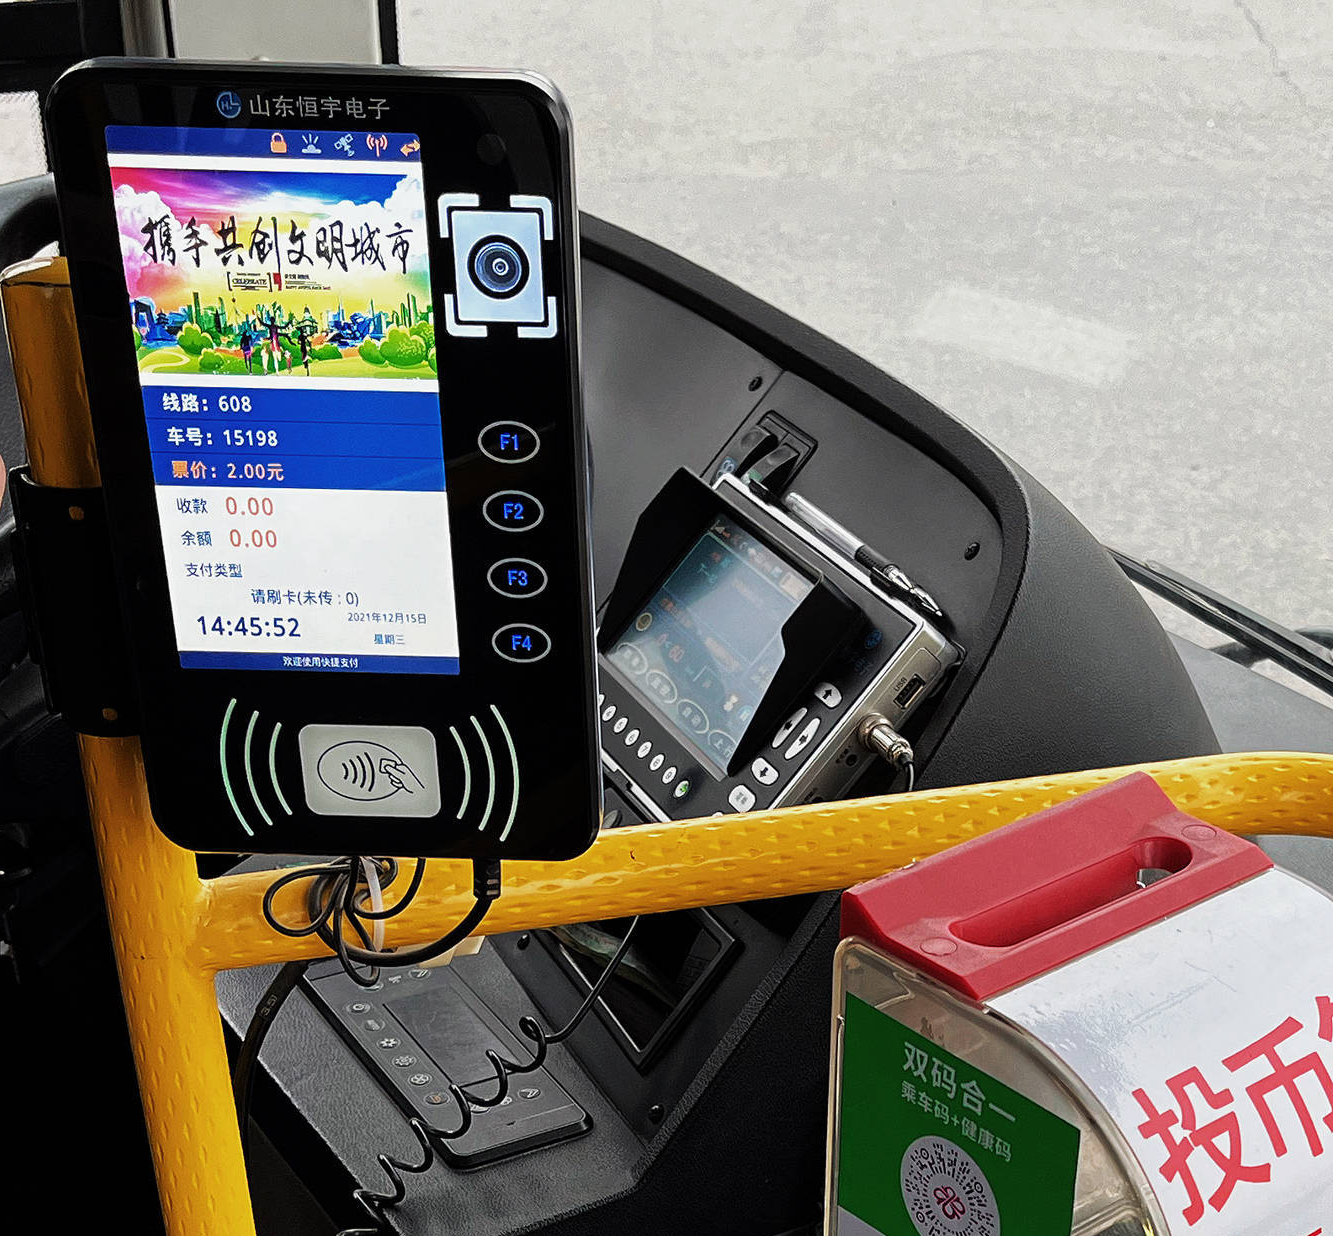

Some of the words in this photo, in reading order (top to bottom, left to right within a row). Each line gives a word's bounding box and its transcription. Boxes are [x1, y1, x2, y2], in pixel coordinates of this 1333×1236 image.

[250, 93, 390, 120] 山东恒宇电子
[142, 214, 415, 276] 携手共创文明城市
[499, 433, 520, 452] F1
[176, 497, 209, 516] 收款
[225, 496, 274, 517] 0.00
[503, 502, 524, 521] F2
[181, 530, 213, 548] 余额
[229, 529, 278, 549] 0.00
[185, 562, 243, 580] 支付类型
[507, 569, 528, 587] F3
[196, 614, 302, 639] 14:45:52
[347, 610, 428, 626] 2021年12月15日
[373, 632, 406, 647] 星期三
[511, 634, 533, 651] F4
[282, 656, 359, 670] 欢迎使用快捷支付
[901, 1041, 1016, 1124] 双码合一
[901, 1080, 1013, 1164] 乘车码+健康码
